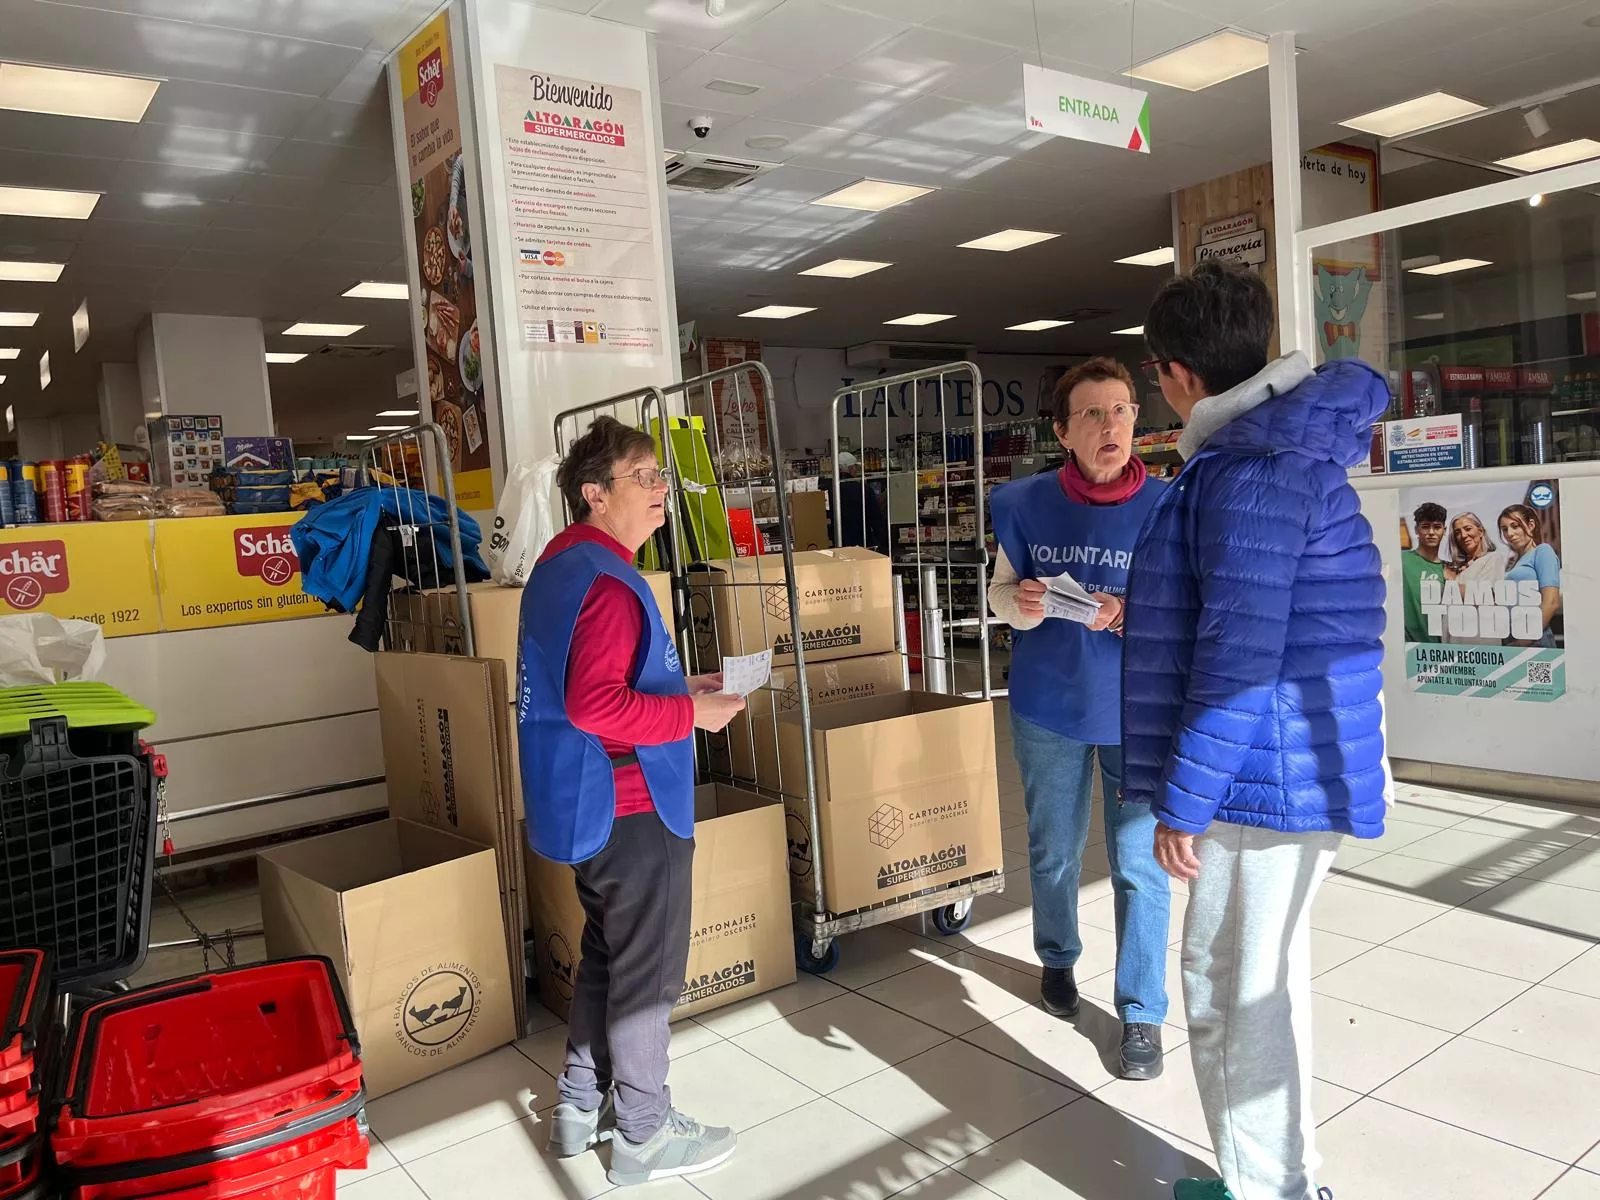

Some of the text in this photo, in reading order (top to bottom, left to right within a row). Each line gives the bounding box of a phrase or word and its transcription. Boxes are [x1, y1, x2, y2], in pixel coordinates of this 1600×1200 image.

[419, 58, 441, 86] Schär
[530, 74, 613, 111] Bienvenido
[523, 109, 624, 135] ALTOARAGÓN
[1058, 95, 1120, 124] ENTRADA
[416, 124, 430, 142] sabor
[430, 118, 440, 132] que
[535, 125, 616, 145] SUPERMERCADOS
[1331, 163, 1342, 176] de
[1348, 166, 1366, 184] hoy
[513, 184, 539, 192] Reservado
[545, 187, 565, 195] derecho
[1204, 216, 1254, 237] ALTOARAGÓN
[841, 368, 1025, 418] LÁCTEOS
[239, 532, 299, 557] Schä
[1028, 543, 1133, 570] VOLUNTARI
[0, 549, 61, 578] chär
[805, 585, 863, 598] CARTONAJES
[1420, 580, 1542, 606] DAMOS
[112, 609, 140, 623] 1922
[181, 593, 309, 617] Los expertos sin gluten
[1421, 604, 1543, 640] TODO
[783, 637, 853, 653] SUERMERCADOS
[1416, 649, 1505, 666] LA GRAN RECOGIDA
[1416, 664, 1476, 676] 7, 8 Y 9 NOVIEMBRE
[818, 683, 874, 698] CARTONAJES
[1446, 677, 1454, 685] AL
[1454, 677, 1497, 689] VOLUNTARIADO
[909, 800, 968, 821] CARTONAJES
[940, 809, 968, 820] OSCENSE
[877, 843, 966, 878] ALTOARAGÓN
[887, 859, 958, 886] SUPERMERCADOS
[690, 913, 756, 939] ARTONAJES
[724, 923, 756, 937] OSCENSE
[682, 960, 754, 991] OARAGÓN
[393, 962, 481, 1020] BANCOS DE ALIMENTOS
[676, 976, 745, 1005] ERMERCADOS
[395, 999, 482, 1057] BANCOS DE ALIMENTOS
